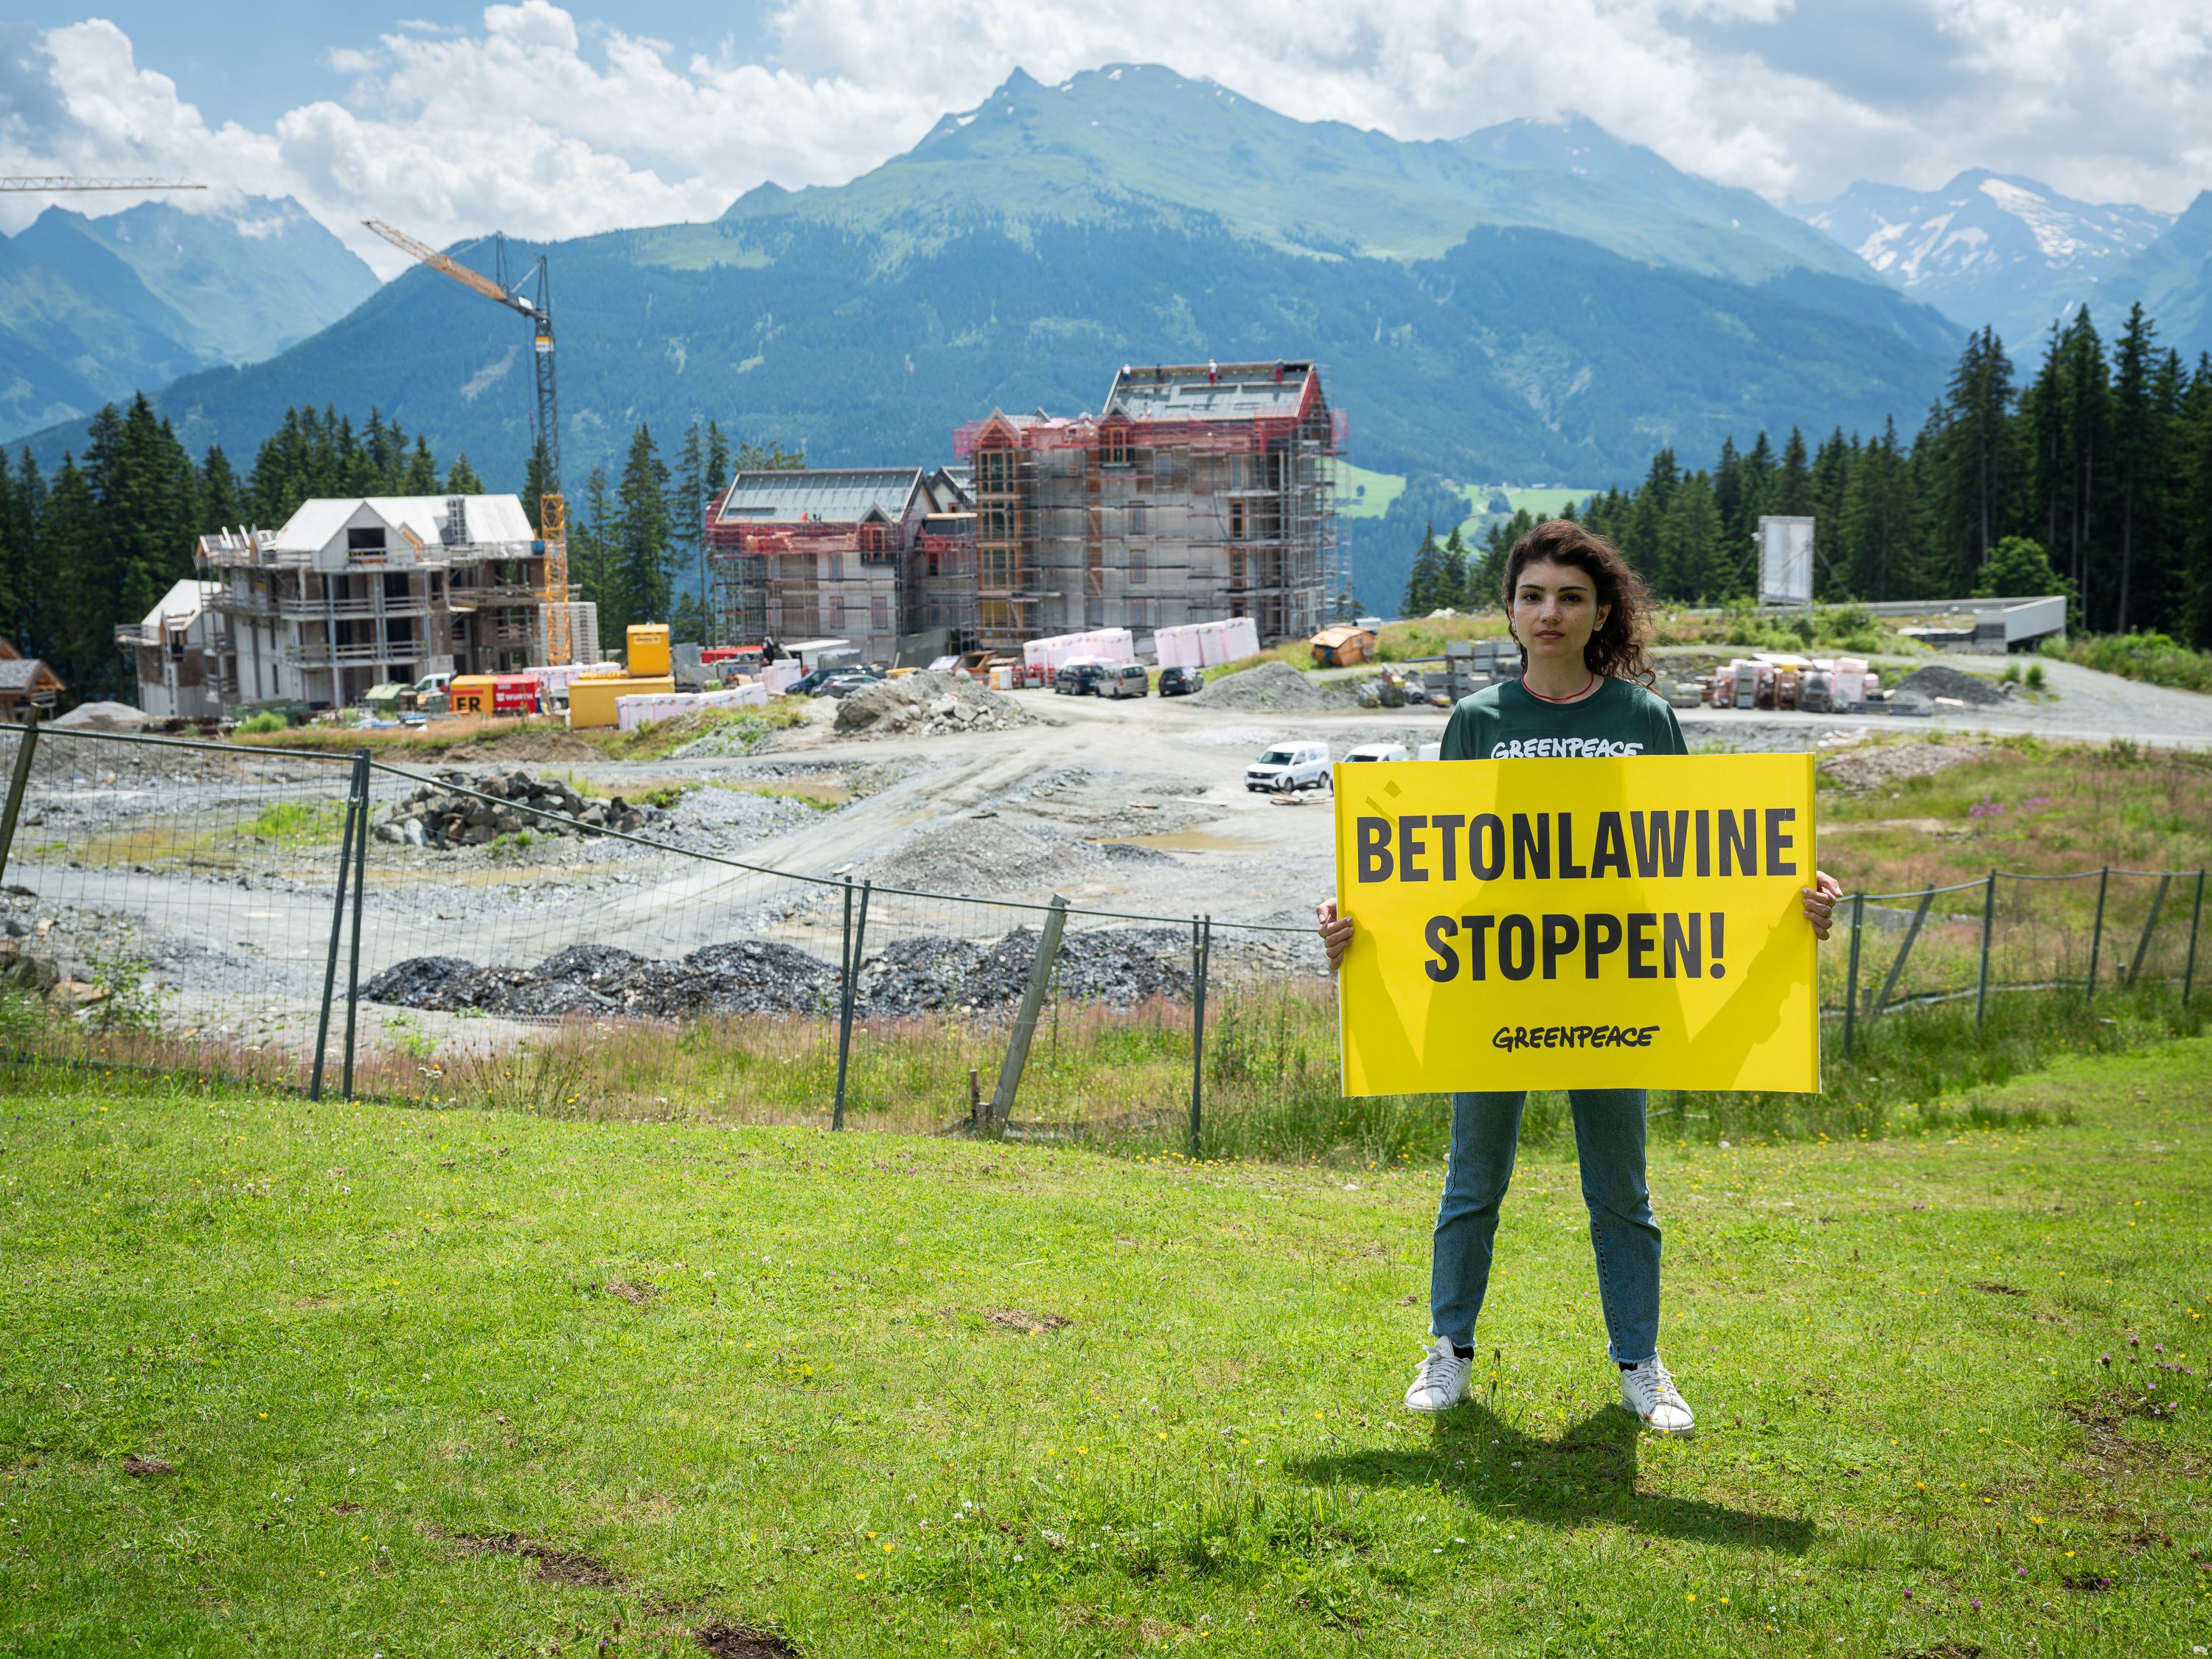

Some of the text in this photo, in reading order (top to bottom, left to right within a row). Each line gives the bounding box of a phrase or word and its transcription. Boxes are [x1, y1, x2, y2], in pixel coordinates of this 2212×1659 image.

[1491, 738, 1644, 759] GREENPEACE
[1357, 808, 1796, 883] BETONLAWINE
[1425, 913, 1725, 982] STOPPEN!
[1492, 1026, 1660, 1052] GREENPEACE
